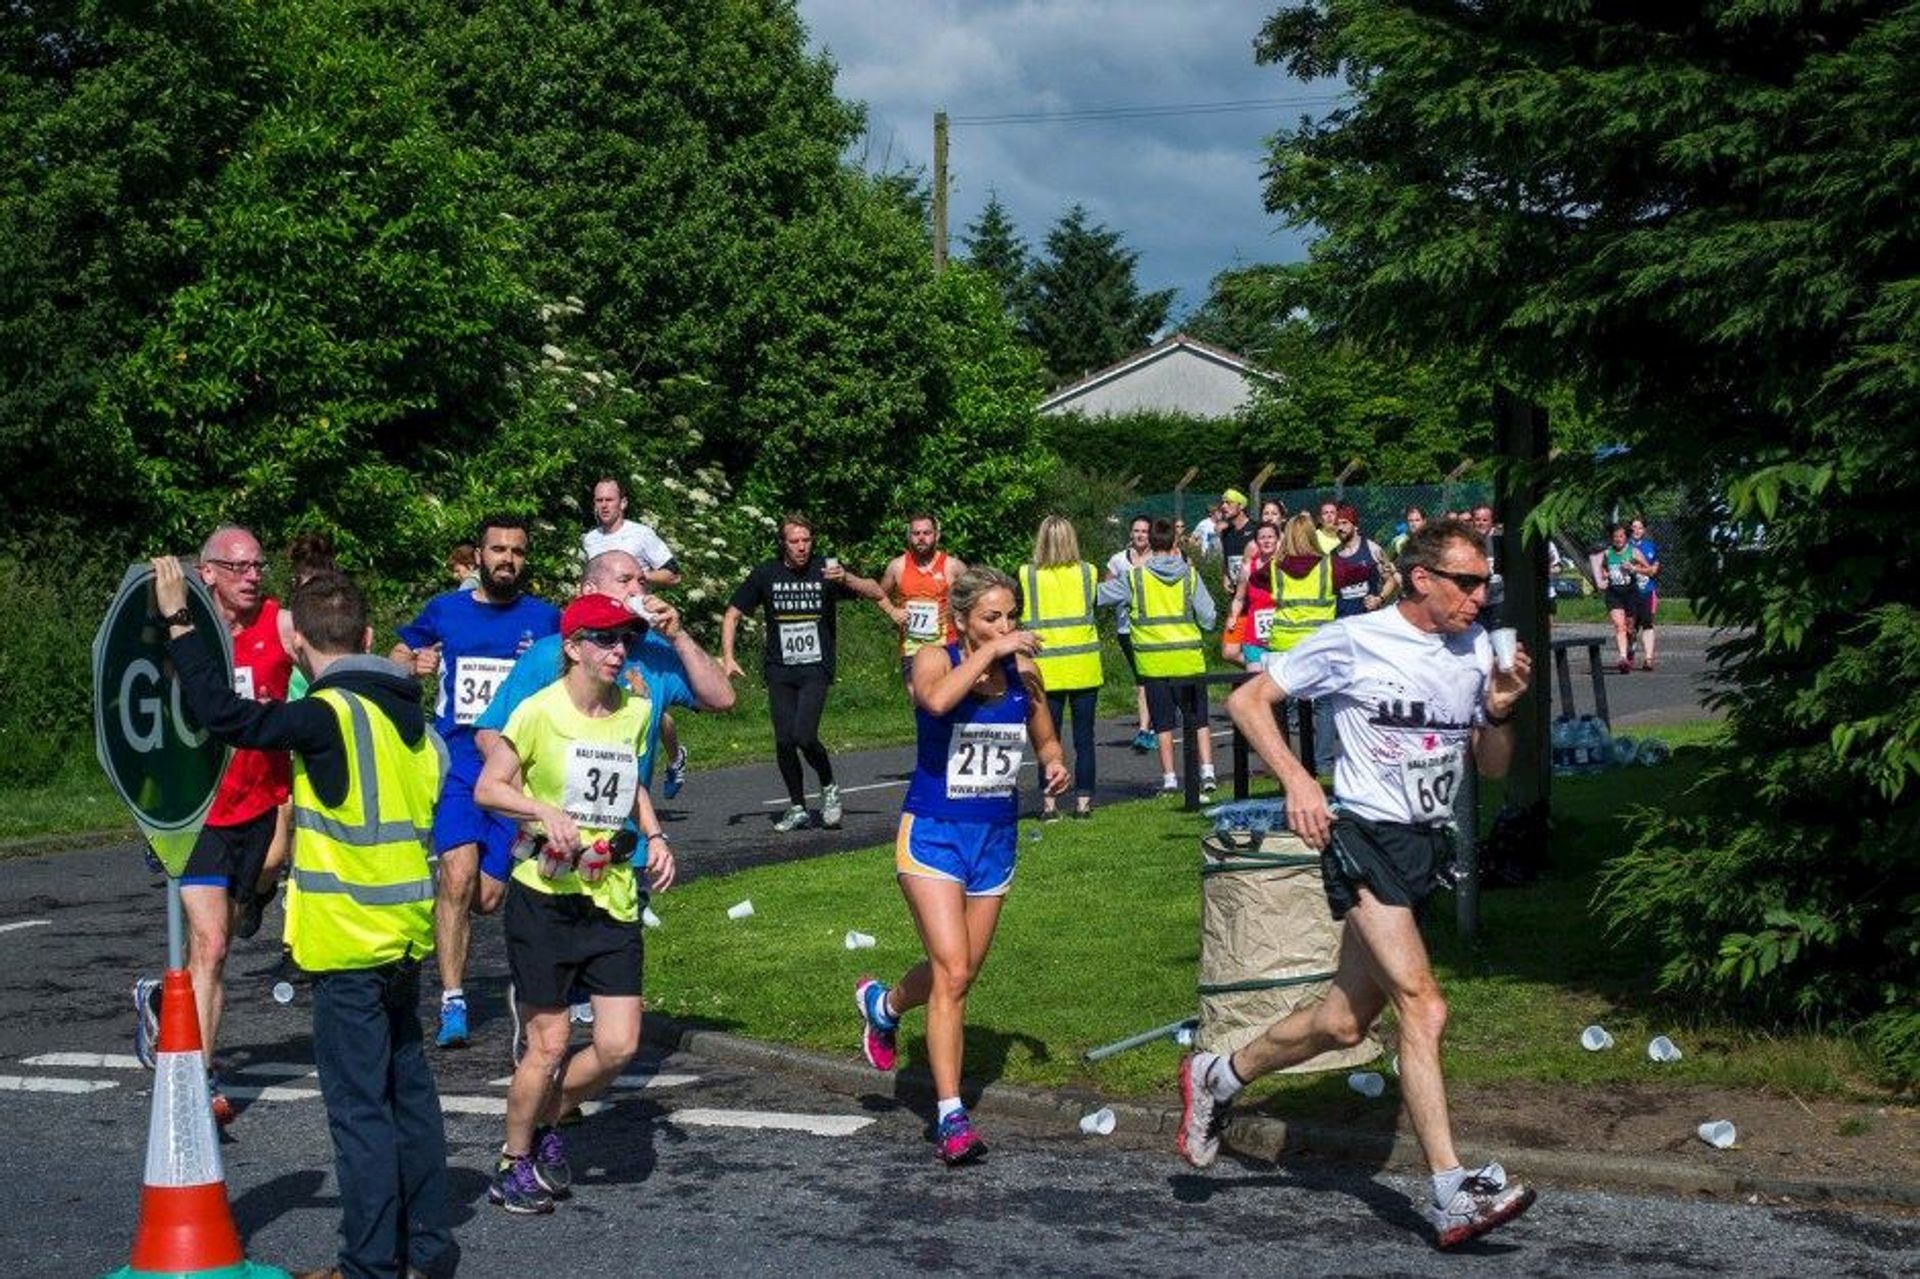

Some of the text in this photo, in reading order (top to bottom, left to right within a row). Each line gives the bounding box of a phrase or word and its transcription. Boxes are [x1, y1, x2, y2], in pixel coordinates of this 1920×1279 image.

[772, 582, 823, 592] MAKING
[773, 600, 823, 610] VISIBLE
[786, 635, 815, 653] 409
[460, 677, 503, 706] 34
[957, 743, 1011, 776] 215
[583, 767, 621, 806] 34
